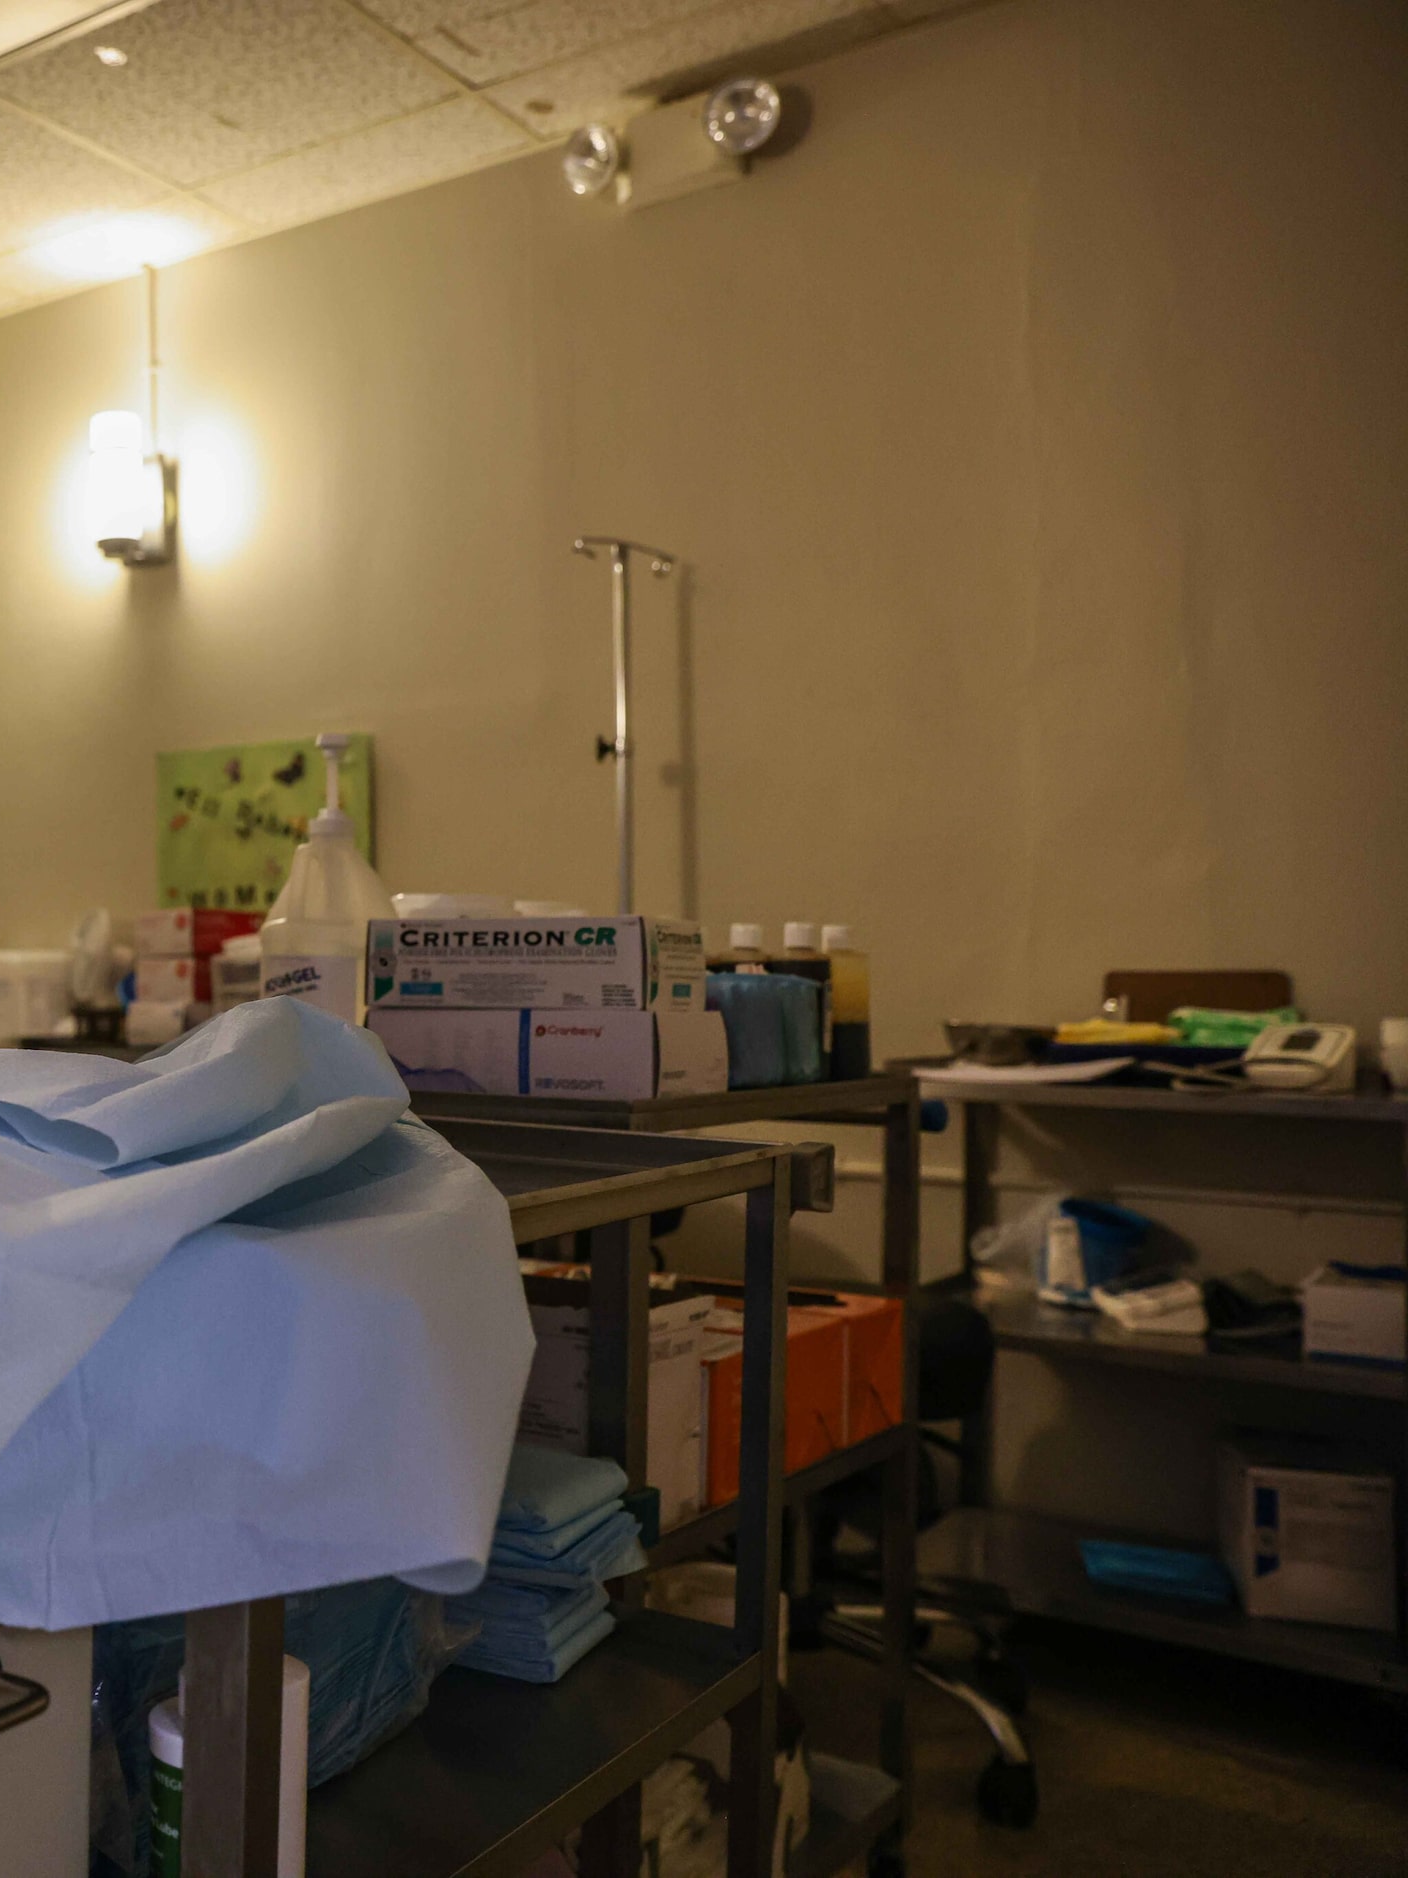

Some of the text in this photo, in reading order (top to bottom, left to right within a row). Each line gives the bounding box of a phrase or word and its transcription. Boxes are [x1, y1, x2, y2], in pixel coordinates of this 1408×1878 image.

[400, 927, 616, 947] CRITERION CR
[548, 1025, 604, 1038] Cranberry
